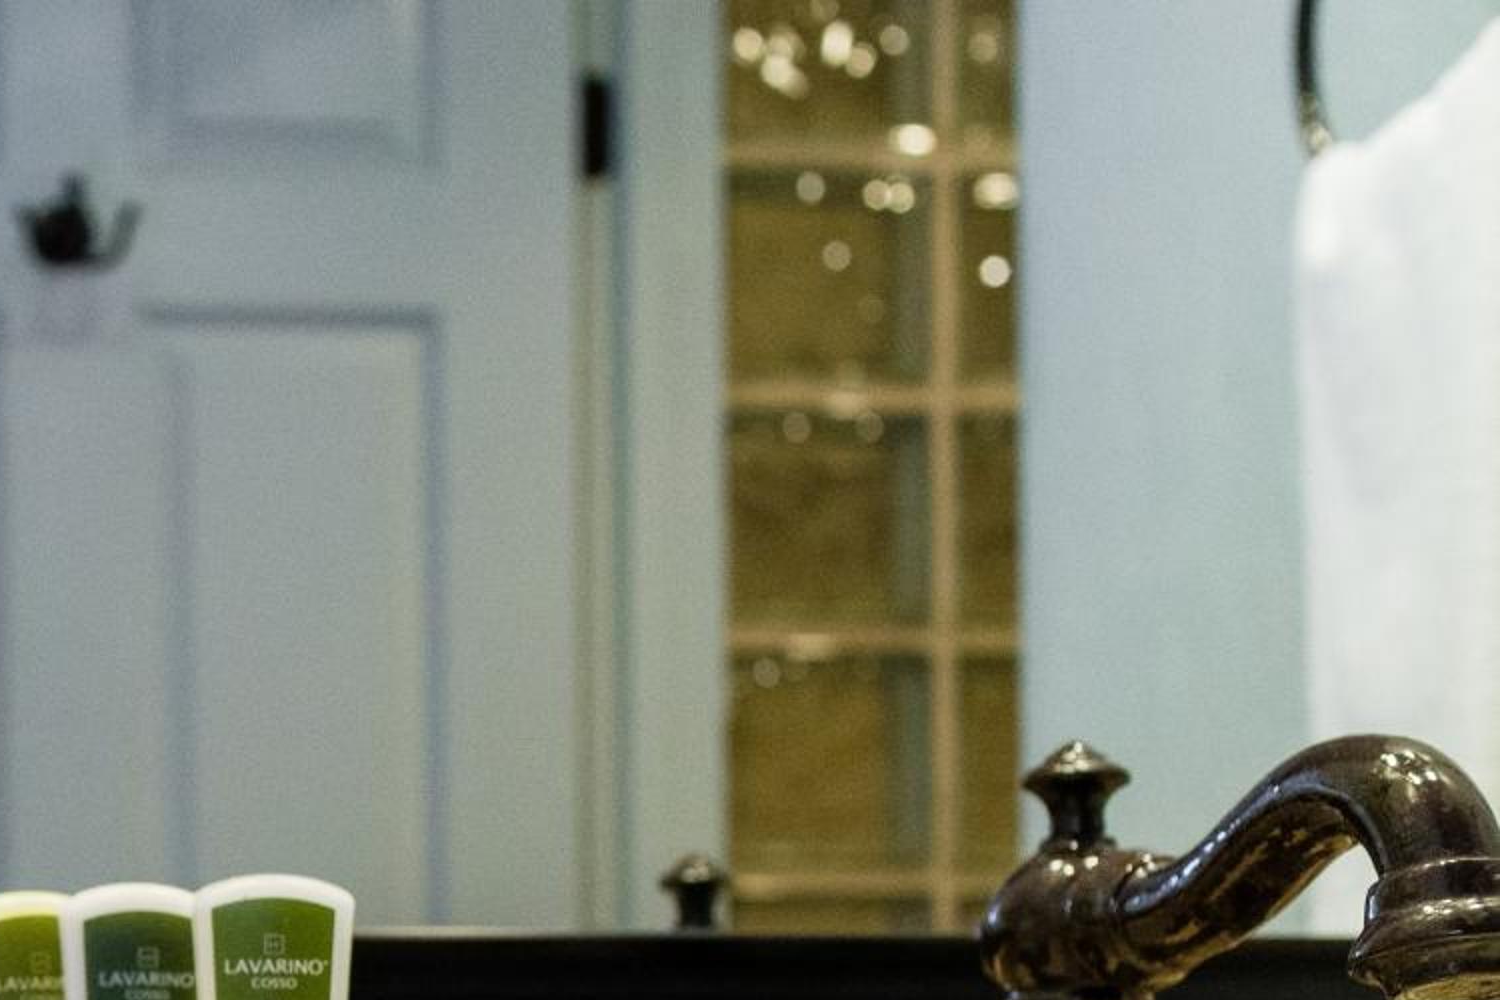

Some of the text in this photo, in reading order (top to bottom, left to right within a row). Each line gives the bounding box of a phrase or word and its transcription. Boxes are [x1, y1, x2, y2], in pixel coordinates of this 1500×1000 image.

[224, 958, 329, 976] LAVARINO
[98, 970, 197, 990] LAVARINO
[251, 977, 298, 991] COSSO
